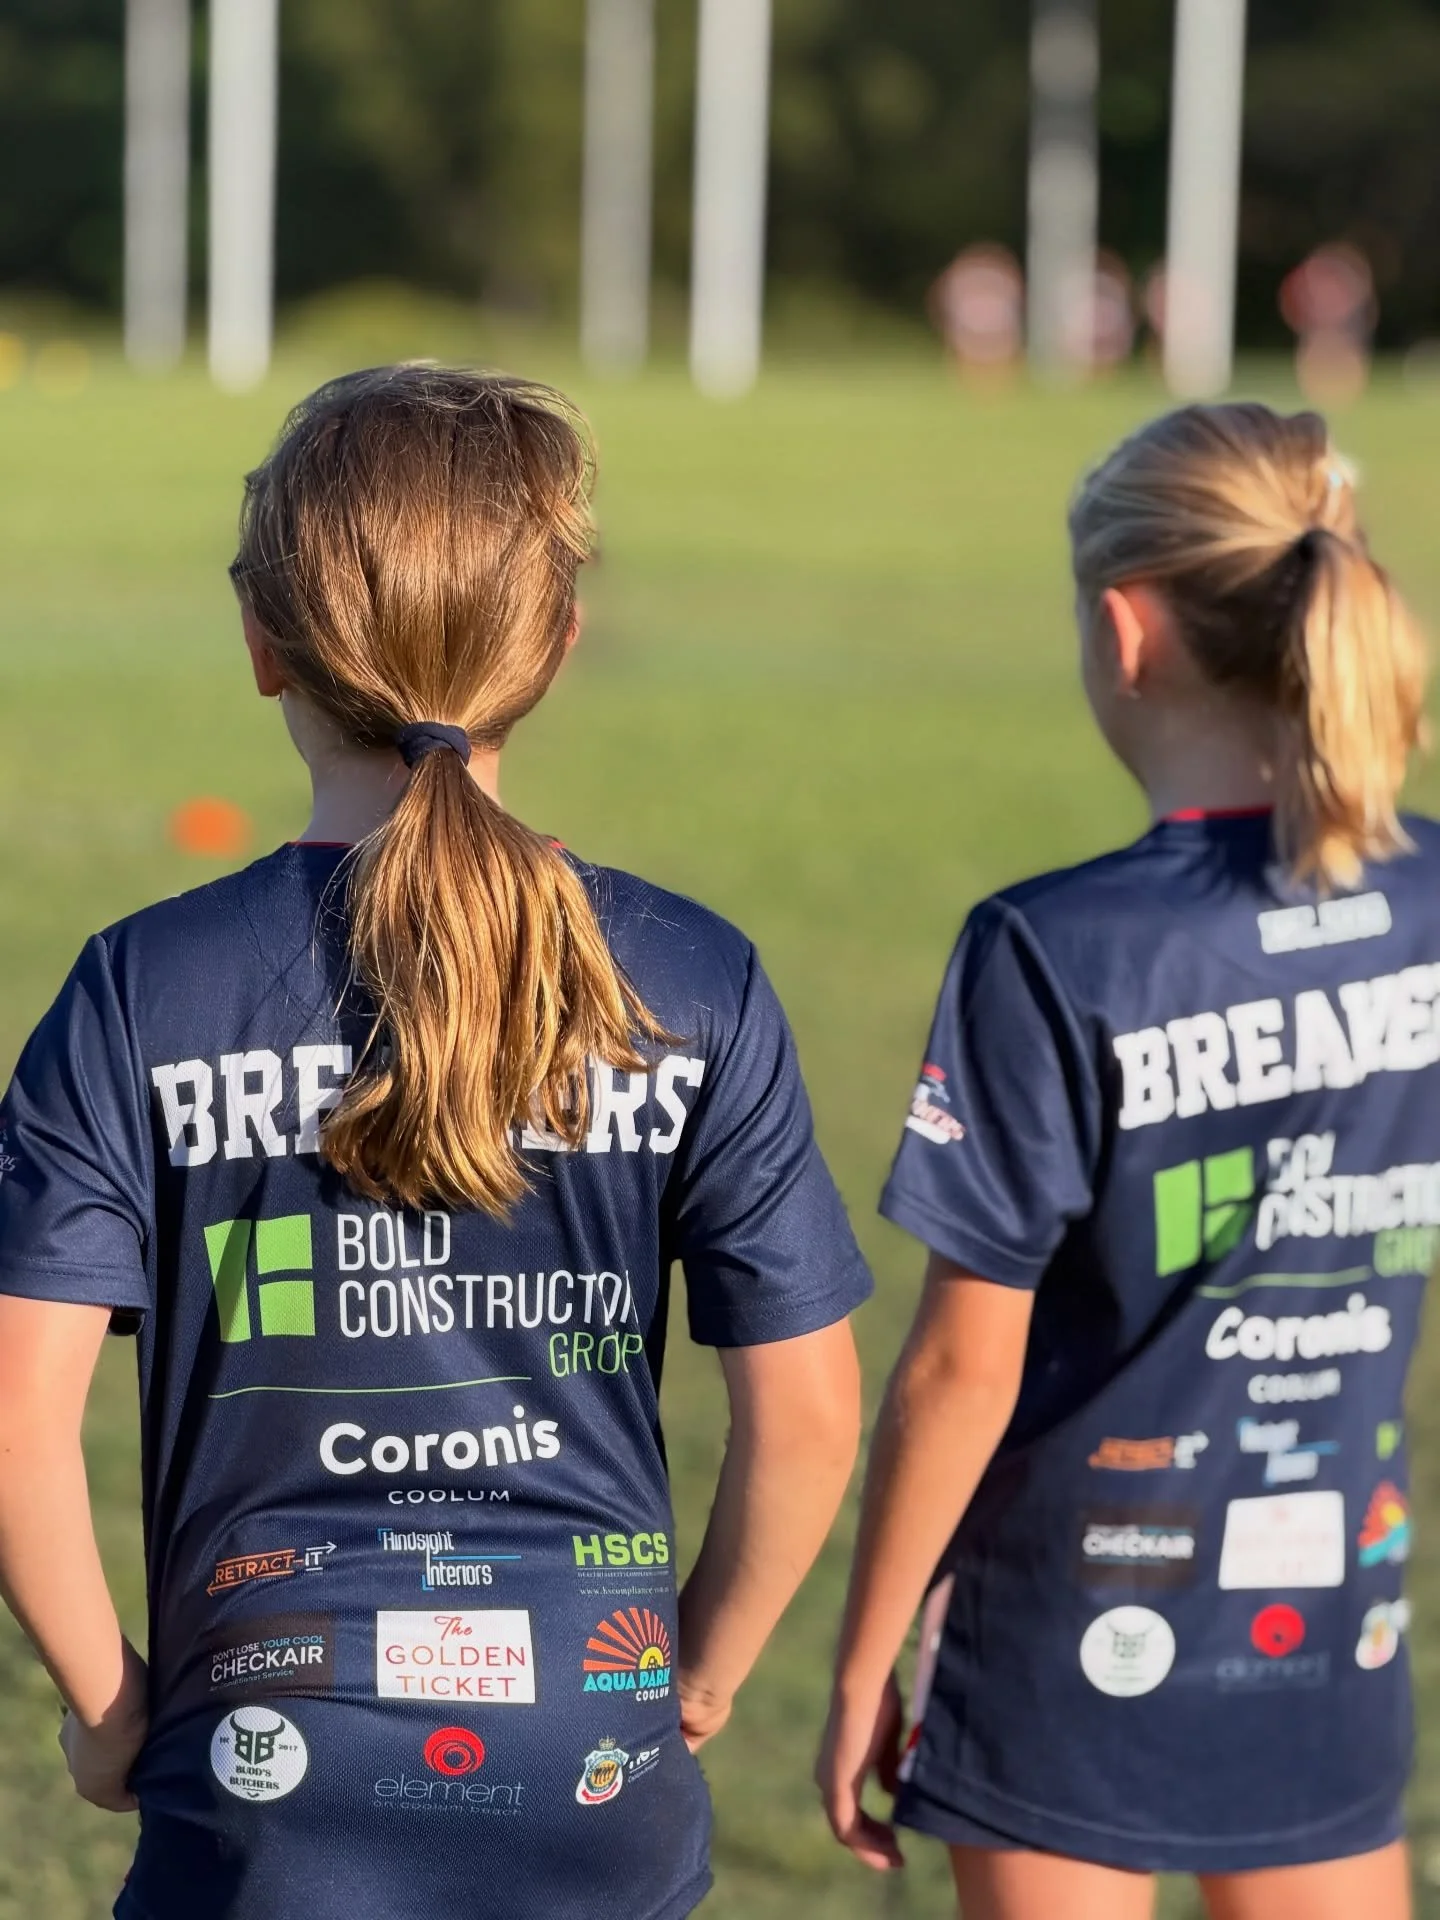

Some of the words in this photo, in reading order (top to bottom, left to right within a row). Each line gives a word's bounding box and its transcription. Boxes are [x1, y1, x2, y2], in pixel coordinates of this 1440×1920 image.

[1113, 962, 1440, 1130] BREAKE
[151, 1044, 706, 1167] BRERS
[337, 1211, 450, 1272] BOLD
[319, 1404, 561, 1475] Coronis
[388, 1490, 510, 1505] COOLUM
[383, 1531, 455, 1555] Hindsight
[572, 1532, 669, 1566] HSCS
[427, 1556, 493, 1586] Interiors
[434, 1616, 473, 1641] The
[237, 1642, 260, 1654] LOSE
[262, 1638, 290, 1649] YOUR
[293, 1635, 326, 1645] COOL
[385, 1645, 526, 1667] GOLDEN
[211, 1645, 324, 1683] CHECKAIR
[396, 1676, 517, 1697] TICKET
[583, 1672, 637, 1692] AQUA
[640, 1667, 671, 1688] PARK
[229, 1776, 280, 1790] BUTCHERS
[236, 1765, 272, 1777] BUDD'S
[375, 1774, 525, 1806] element
